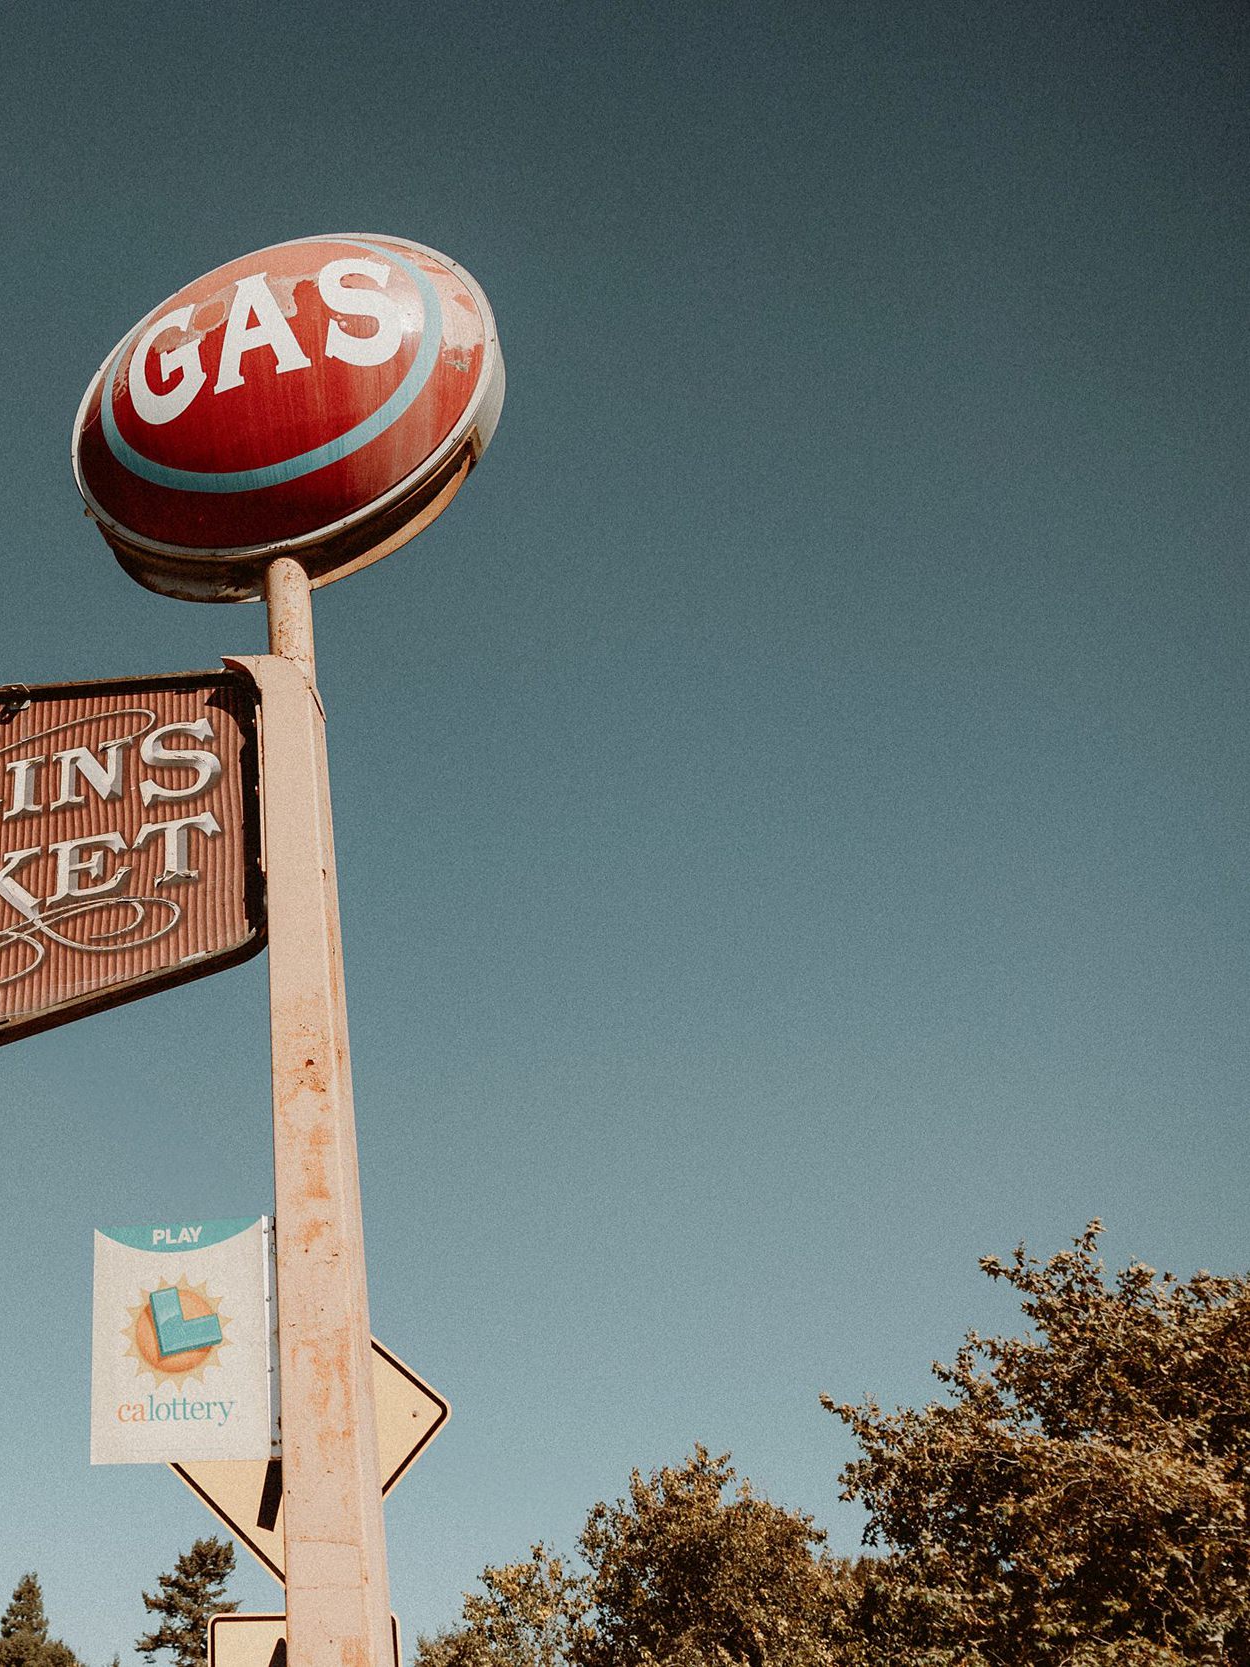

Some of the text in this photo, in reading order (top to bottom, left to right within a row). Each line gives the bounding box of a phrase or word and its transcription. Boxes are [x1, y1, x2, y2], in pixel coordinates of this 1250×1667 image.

[129, 258, 406, 425] GAS
[152, 1226, 203, 1245] PLAY
[118, 1395, 235, 1426] calottery
